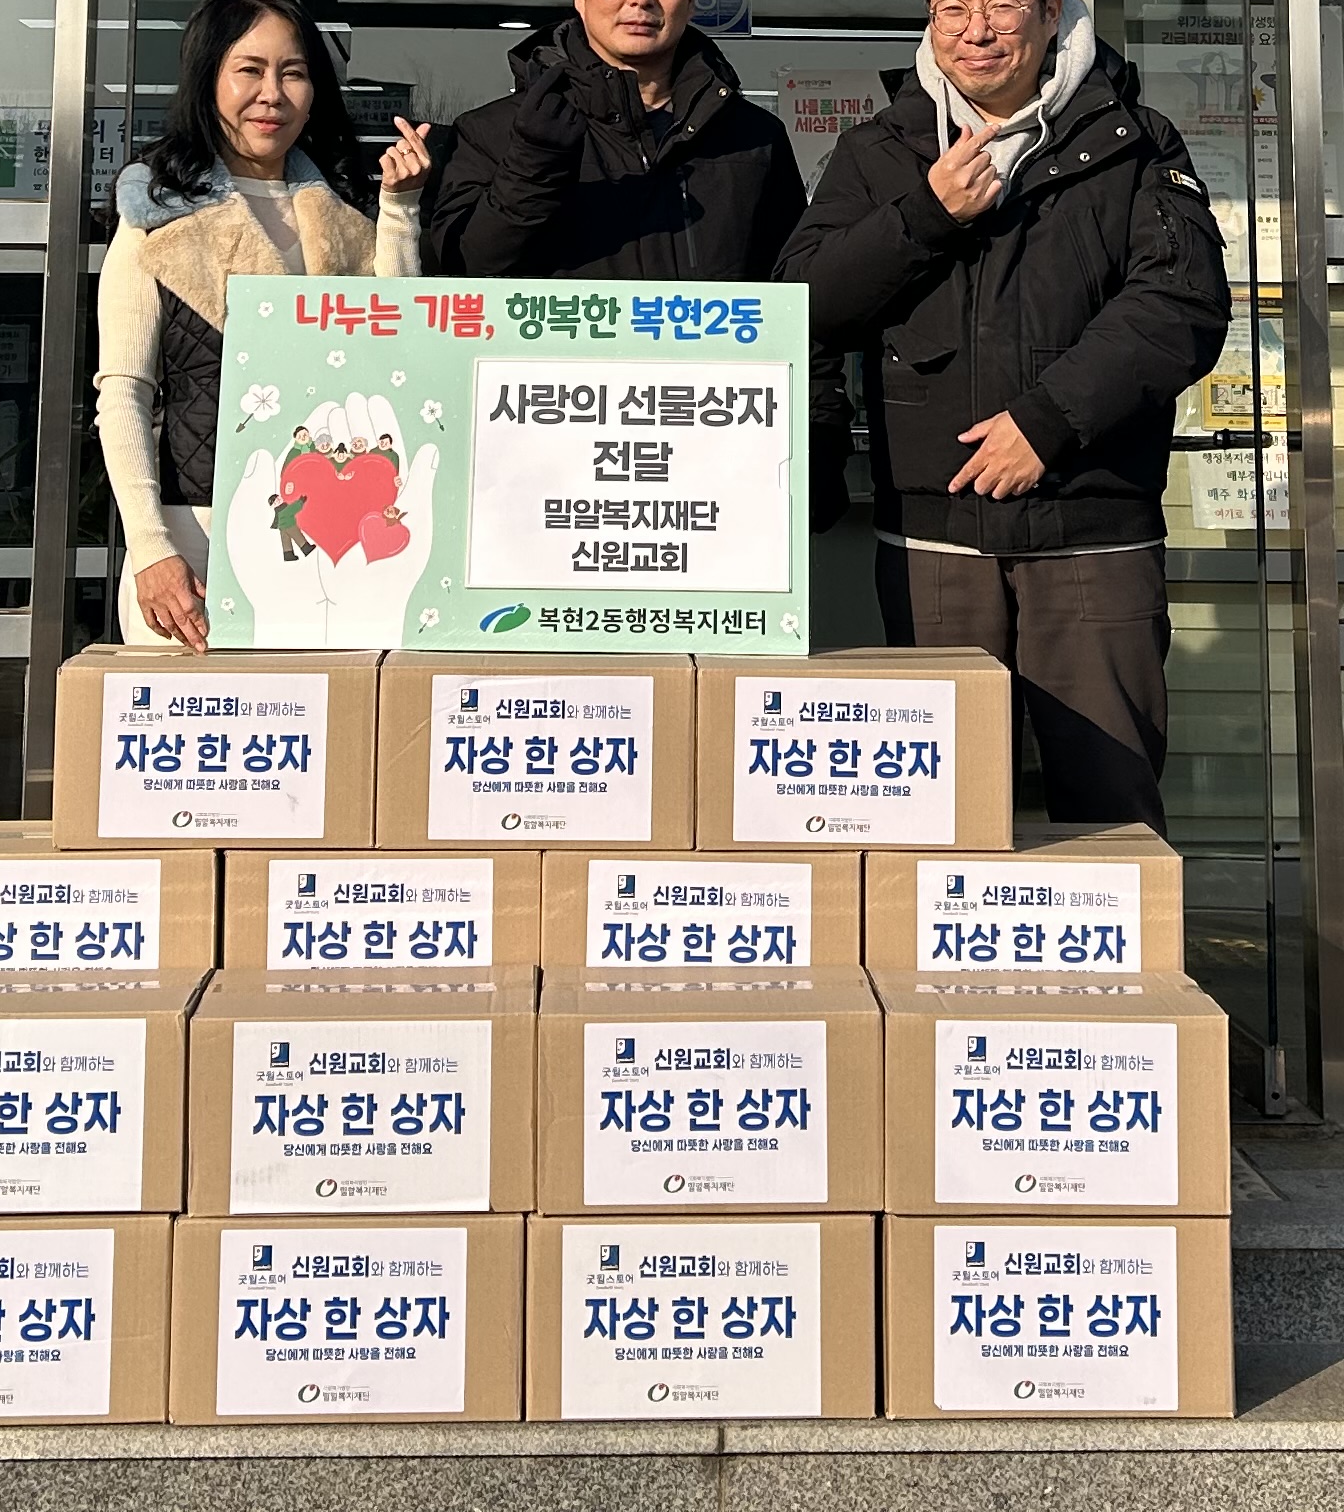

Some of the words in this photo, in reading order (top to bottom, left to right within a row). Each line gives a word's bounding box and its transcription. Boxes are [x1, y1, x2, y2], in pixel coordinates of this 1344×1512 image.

[296, 293, 401, 338] 나누는
[414, 294, 495, 342] 기쁨,
[506, 293, 622, 341] 행복한
[630, 295, 765, 345] 복현2동
[489, 383, 607, 426] 사랑의
[618, 384, 778, 428] 선물상자
[593, 441, 674, 483] 전달
[544, 499, 720, 532] 밀알복지재단
[571, 541, 688, 573] 신원교회
[537, 607, 767, 636] 복현2동행정복지센터
[168, 697, 252, 717] 신원교회와
[257, 702, 306, 716] 함께하는
[496, 699, 579, 719] 신원교회와
[583, 705, 631, 719] 함께하는
[799, 702, 881, 723] 신원교회와
[886, 708, 934, 723] 함께하는
[115, 734, 185, 772] 자상
[197, 733, 231, 772] 한
[242, 734, 312, 772] 상자
[444, 736, 513, 775] 자상
[525, 736, 558, 775] 한
[570, 737, 638, 775] 상자
[749, 738, 817, 777] 자상
[828, 739, 861, 778] 한
[873, 741, 941, 779] 상자
[0, 884, 85, 904] 신원교회와
[89, 889, 138, 903] 함께하는
[334, 883, 417, 904] 신원교회와
[422, 888, 471, 902] 함께하는
[653, 886, 736, 906] 신원교회와
[741, 892, 790, 907] 함께하는
[982, 886, 1065, 907] 신원교회와
[1070, 892, 1118, 907] 함께하는
[30, 921, 63, 960] 한
[75, 921, 144, 960] 상자
[282, 921, 352, 960] 자상
[364, 920, 397, 959] 한
[409, 920, 478, 959] 상자
[602, 923, 671, 962] 자상
[682, 923, 716, 963] 한
[728, 925, 796, 964] 상자
[932, 923, 1000, 962] 자상
[1012, 923, 1046, 962] 한
[1058, 925, 1126, 964] 상자
[61, 1056, 114, 1072] 함께하는
[309, 1052, 400, 1075] 신원교회와
[405, 1058, 458, 1073] 함께하는
[654, 1048, 745, 1070] 신원교회와
[750, 1053, 803, 1069] 함께하는
[1006, 1048, 1096, 1070] 신원교회와
[1101, 1055, 1154, 1071] 함께하는
[45, 1091, 121, 1134] 상자
[253, 1094, 328, 1136] 자상
[341, 1093, 378, 1136] 한
[391, 1092, 466, 1136] 상자
[600, 1090, 674, 1132] 자상
[687, 1088, 724, 1131] 한
[736, 1088, 811, 1131] 상자
[952, 1088, 1026, 1131] 자상
[1038, 1088, 1075, 1132] 한
[1088, 1090, 1162, 1133] 상자
[55, 1142, 87, 1154] 전해요
[284, 1144, 326, 1156] 당신에게
[330, 1143, 362, 1156] 따뜻한
[401, 1142, 432, 1155] 전해요
[631, 1139, 673, 1152] 당신에게
[677, 1139, 709, 1151] 따뜻한
[747, 1138, 778, 1150] 전해요
[982, 1138, 1024, 1151] 당신에게
[1028, 1139, 1060, 1152] 따뜻한
[1098, 1140, 1130, 1152] 전해요
[34, 1262, 88, 1278] 함께하는
[292, 1255, 384, 1278] 신원교회와
[389, 1261, 443, 1276] 함께하는
[639, 1255, 730, 1278] 신원교회와
[735, 1260, 788, 1276] 함께하는
[1004, 1253, 1095, 1275] 신원교회와
[1100, 1259, 1153, 1275] 함께하는
[19, 1298, 96, 1342] 상자
[235, 1298, 311, 1341] 자상
[324, 1296, 361, 1340] 한
[374, 1296, 450, 1340] 상자
[584, 1297, 659, 1340] 자상
[672, 1296, 708, 1340] 한
[722, 1296, 796, 1339] 상자
[950, 1294, 1024, 1337] 자상
[1037, 1294, 1074, 1337] 한
[1087, 1294, 1161, 1337] 상자
[29, 1349, 61, 1362] 전해요
[266, 1348, 309, 1361] 당신에게
[313, 1348, 345, 1360] 따뜻한
[384, 1347, 416, 1360] 전해요
[615, 1348, 657, 1360] 당신에게
[662, 1347, 693, 1360] 따뜻한
[732, 1346, 764, 1359] 전해요
[981, 1345, 1023, 1357] 당신에게
[1028, 1345, 1059, 1357] 따뜻한
[1098, 1345, 1129, 1357] 전해요
